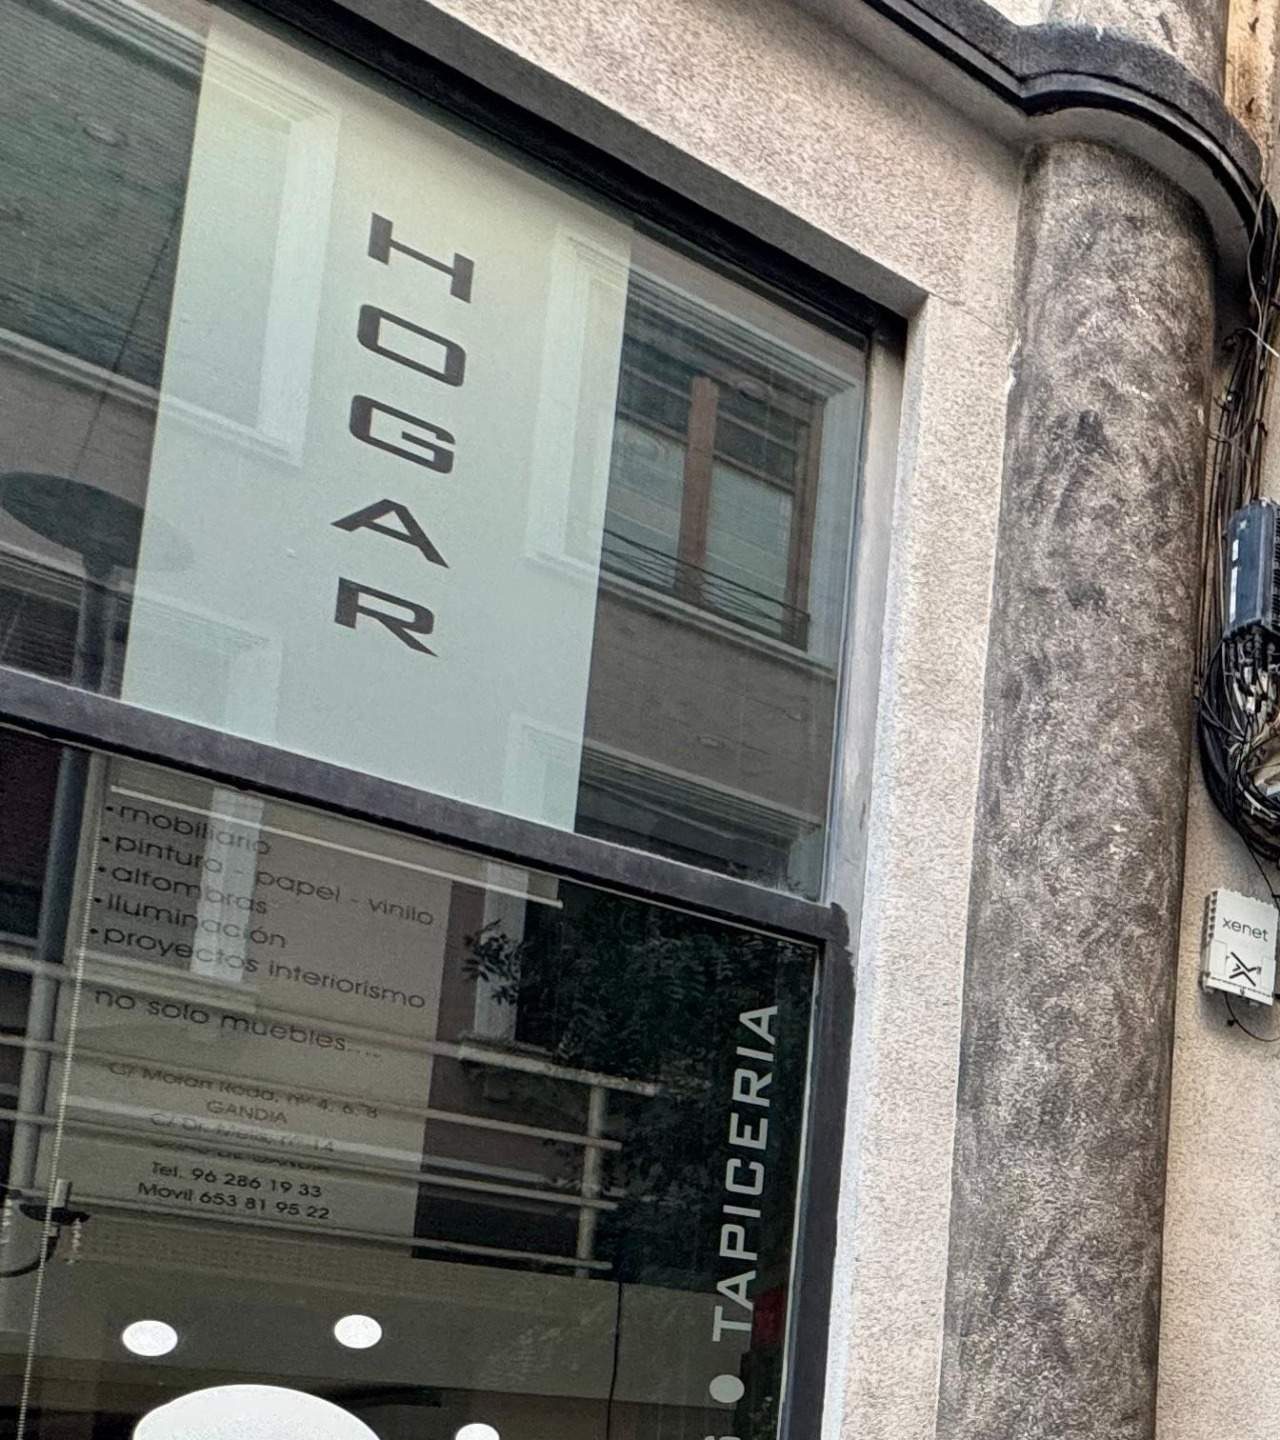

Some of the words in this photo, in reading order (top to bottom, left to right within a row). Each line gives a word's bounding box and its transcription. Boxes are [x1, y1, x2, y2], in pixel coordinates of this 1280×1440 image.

[330, 212, 475, 657] HOGAR
[118, 805, 272, 855] mobiliario
[111, 866, 268, 915] alfombras
[114, 835, 224, 874] pintura
[255, 870, 341, 902] papel
[367, 897, 434, 926] vinilo
[1222, 917, 1269, 943] xenet
[103, 927, 259, 973] proyectos
[268, 960, 426, 1009] interiorismo
[94, 989, 136, 1010] no
[148, 1000, 210, 1024] solo
[205, 1099, 288, 1124] GANDIA
[151, 1161, 184, 1179] Tel.
[191, 1167, 217, 1184] 96
[223, 1172, 262, 1190] 286
[270, 1178, 293, 1194] 19
[298, 1183, 322, 1198] 33
[712, 1004, 778, 1343] TAPICERIA
[199, 1190, 238, 1208] 653
[244, 1197, 266, 1211] 81
[275, 1201, 300, 1216] 95
[305, 1205, 330, 1220] 22
